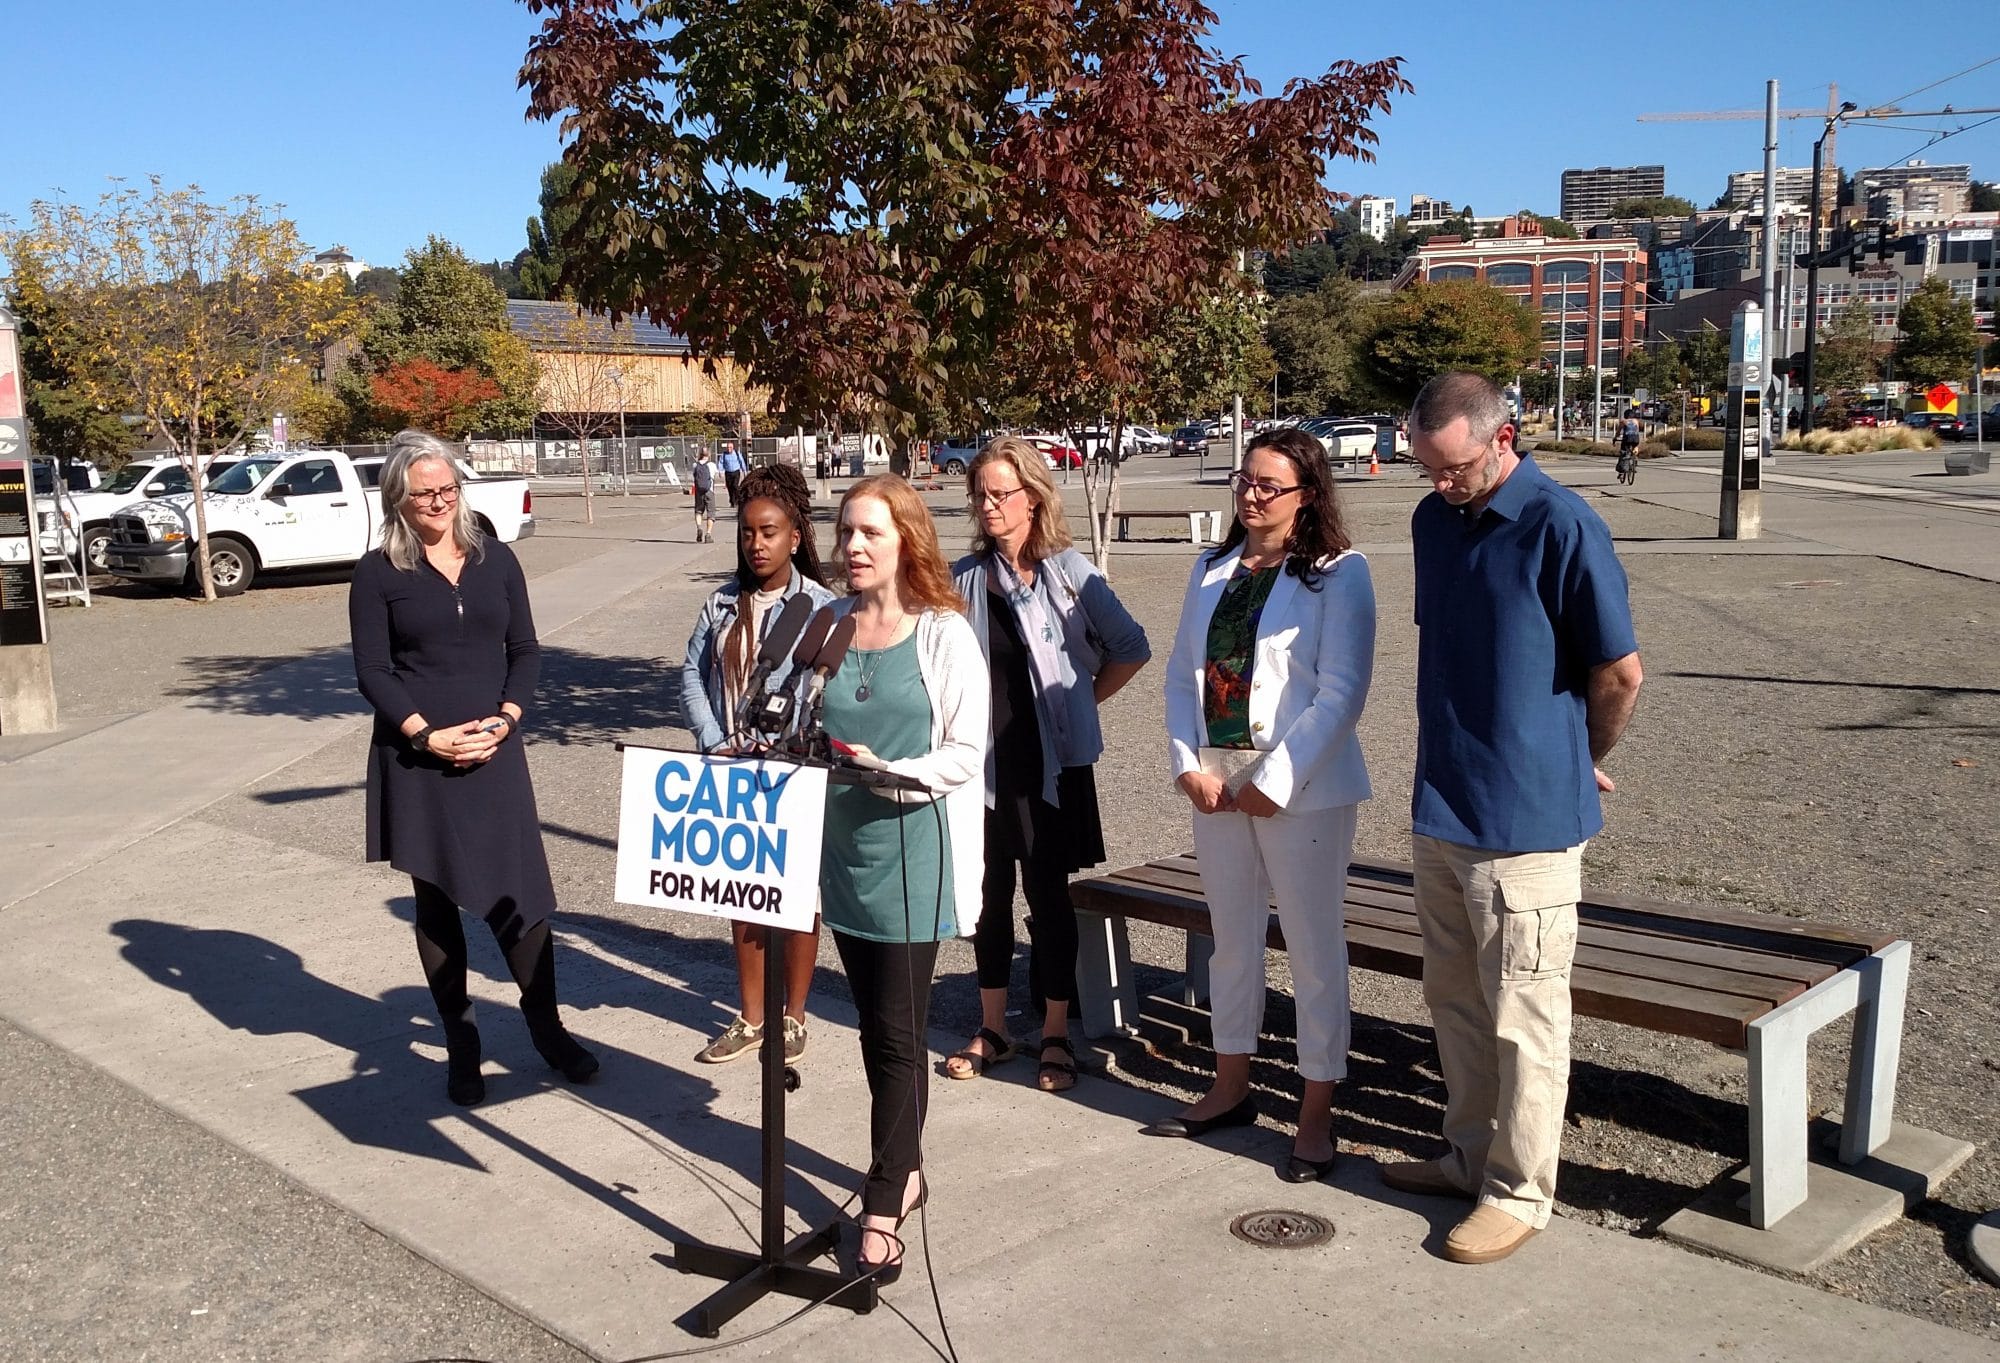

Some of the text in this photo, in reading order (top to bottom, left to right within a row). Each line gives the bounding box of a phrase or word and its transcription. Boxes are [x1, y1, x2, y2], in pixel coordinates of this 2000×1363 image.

[655, 760, 790, 824] CARY
[651, 813, 788, 877] MOON
[649, 869, 783, 914] FOR MAYOR
